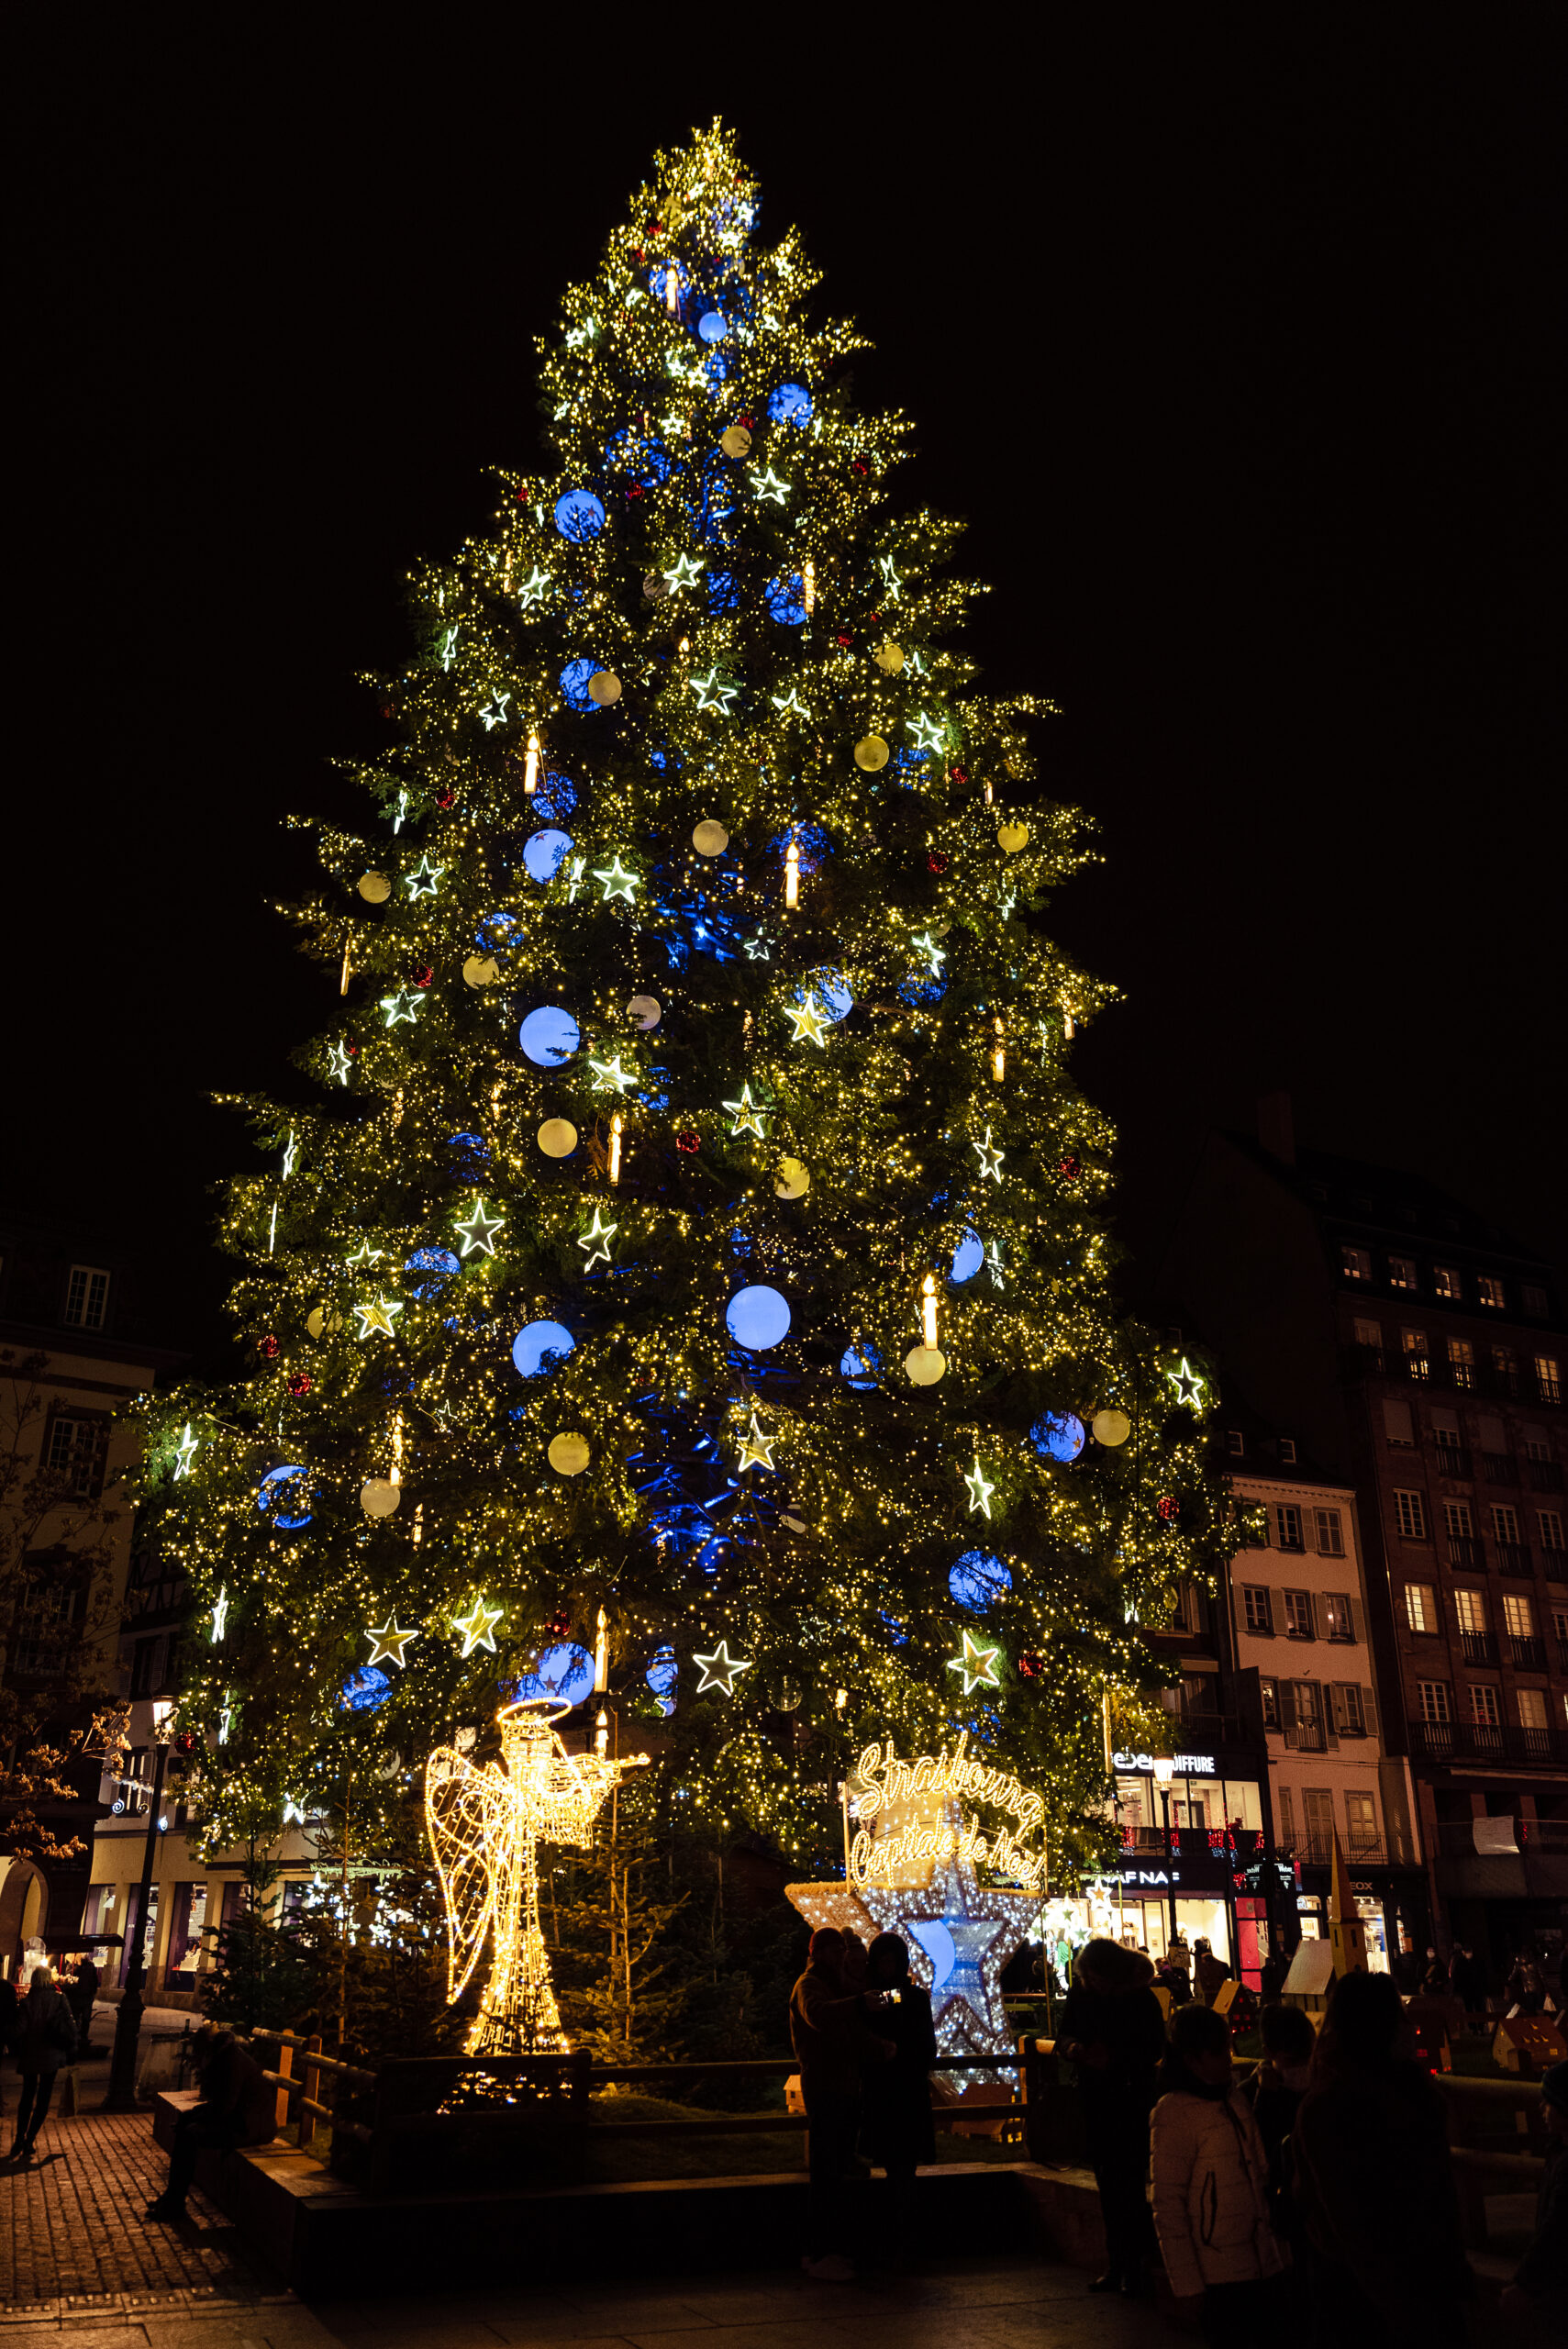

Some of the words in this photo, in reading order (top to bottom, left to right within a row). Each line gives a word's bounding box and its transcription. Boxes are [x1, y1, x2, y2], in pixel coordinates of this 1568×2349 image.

[858, 1731, 1045, 1844] Strasbourg
[850, 1808, 955, 1887] Capitale
[959, 1813, 988, 1862] de
[988, 1826, 1047, 1890] Noël
